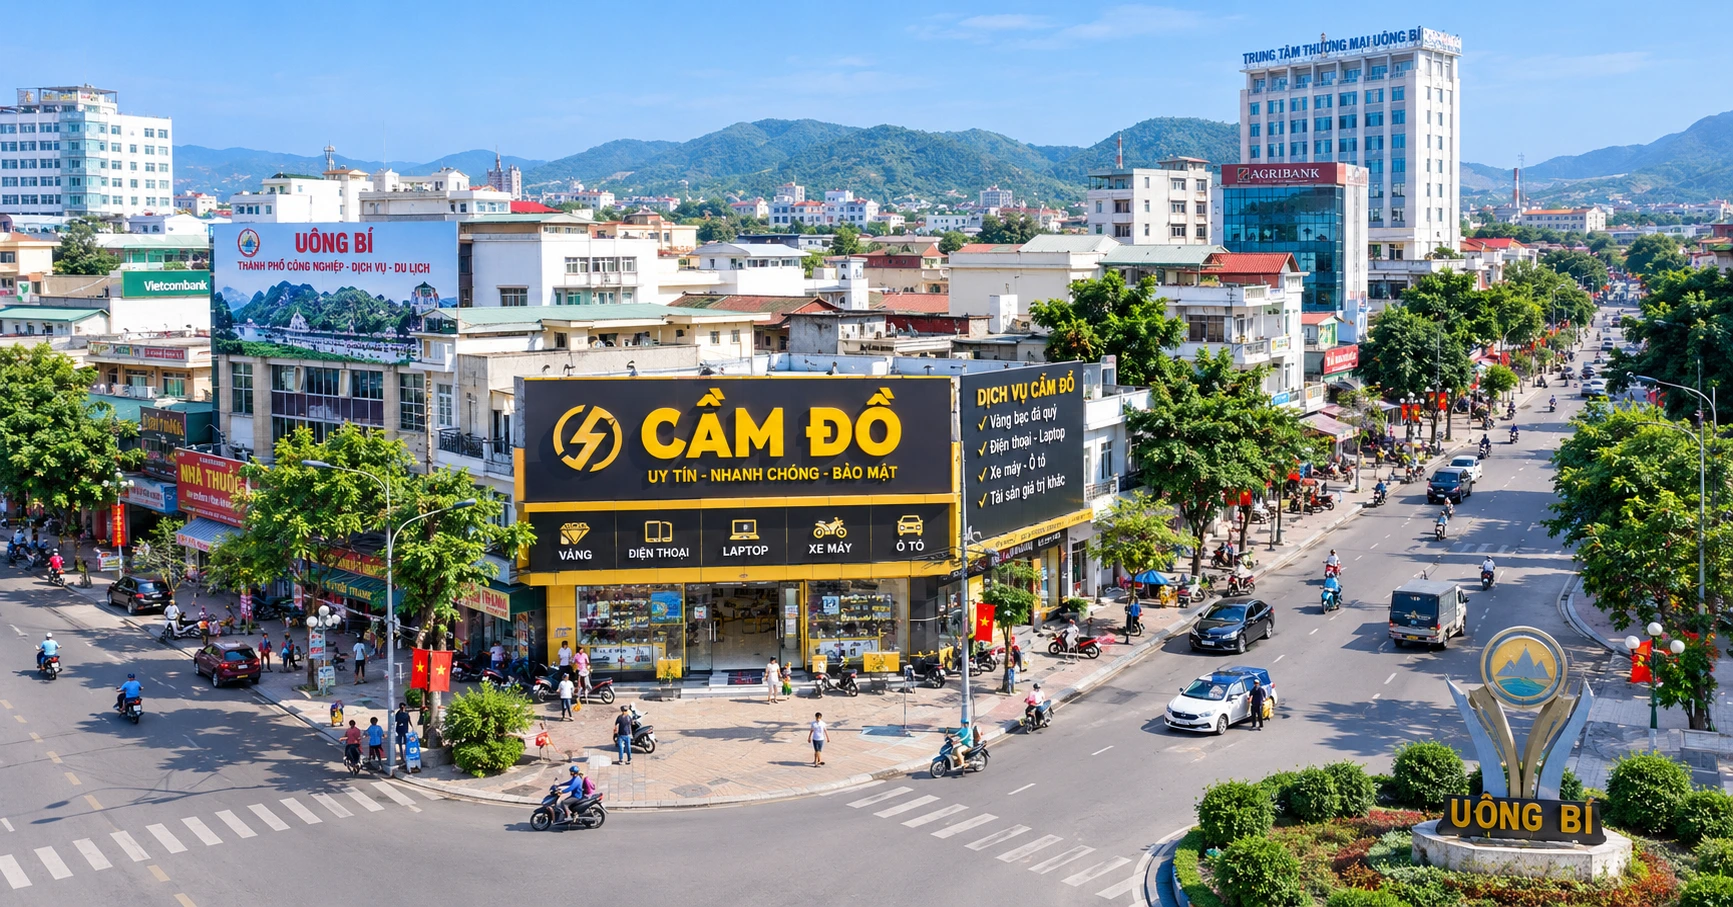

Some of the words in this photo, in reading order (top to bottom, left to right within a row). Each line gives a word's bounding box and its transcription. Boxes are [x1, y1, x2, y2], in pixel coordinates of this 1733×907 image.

[1242, 49, 1276, 64] TRUNG
[1278, 44, 1300, 60] TÂM
[1373, 30, 1406, 47] UÔNG
[1408, 25, 1421, 42] BÍ
[1250, 168, 1320, 179] AGRIBANK
[295, 227, 348, 254] UÔNG
[354, 226, 374, 254] BÍ
[351, 262, 372, 275] DỊCH
[375, 262, 387, 275] VỤ
[394, 262, 407, 273] DU
[143, 279, 208, 291] Vietcombank
[977, 385, 1009, 409] DỊCH
[1011, 382, 1028, 404] VỤ
[641, 388, 784, 460] CẦM
[805, 387, 902, 457] ĐỒ
[1039, 427, 1066, 444] Laptop
[648, 469, 669, 483] UY
[672, 466, 697, 483] TÍN
[710, 467, 764, 482] NHANH
[767, 463, 820, 482] CHÓNG
[867, 463, 898, 482] MẬT
[990, 465, 1001, 480] Xe
[628, 547, 654, 560] ĐIỆN
[656, 547, 690, 560] THOẠI
[722, 545, 769, 557] LAPTOP
[808, 543, 824, 555] XE
[1451, 792, 1543, 832] UÔNG
[1560, 796, 1593, 835] BÍ
